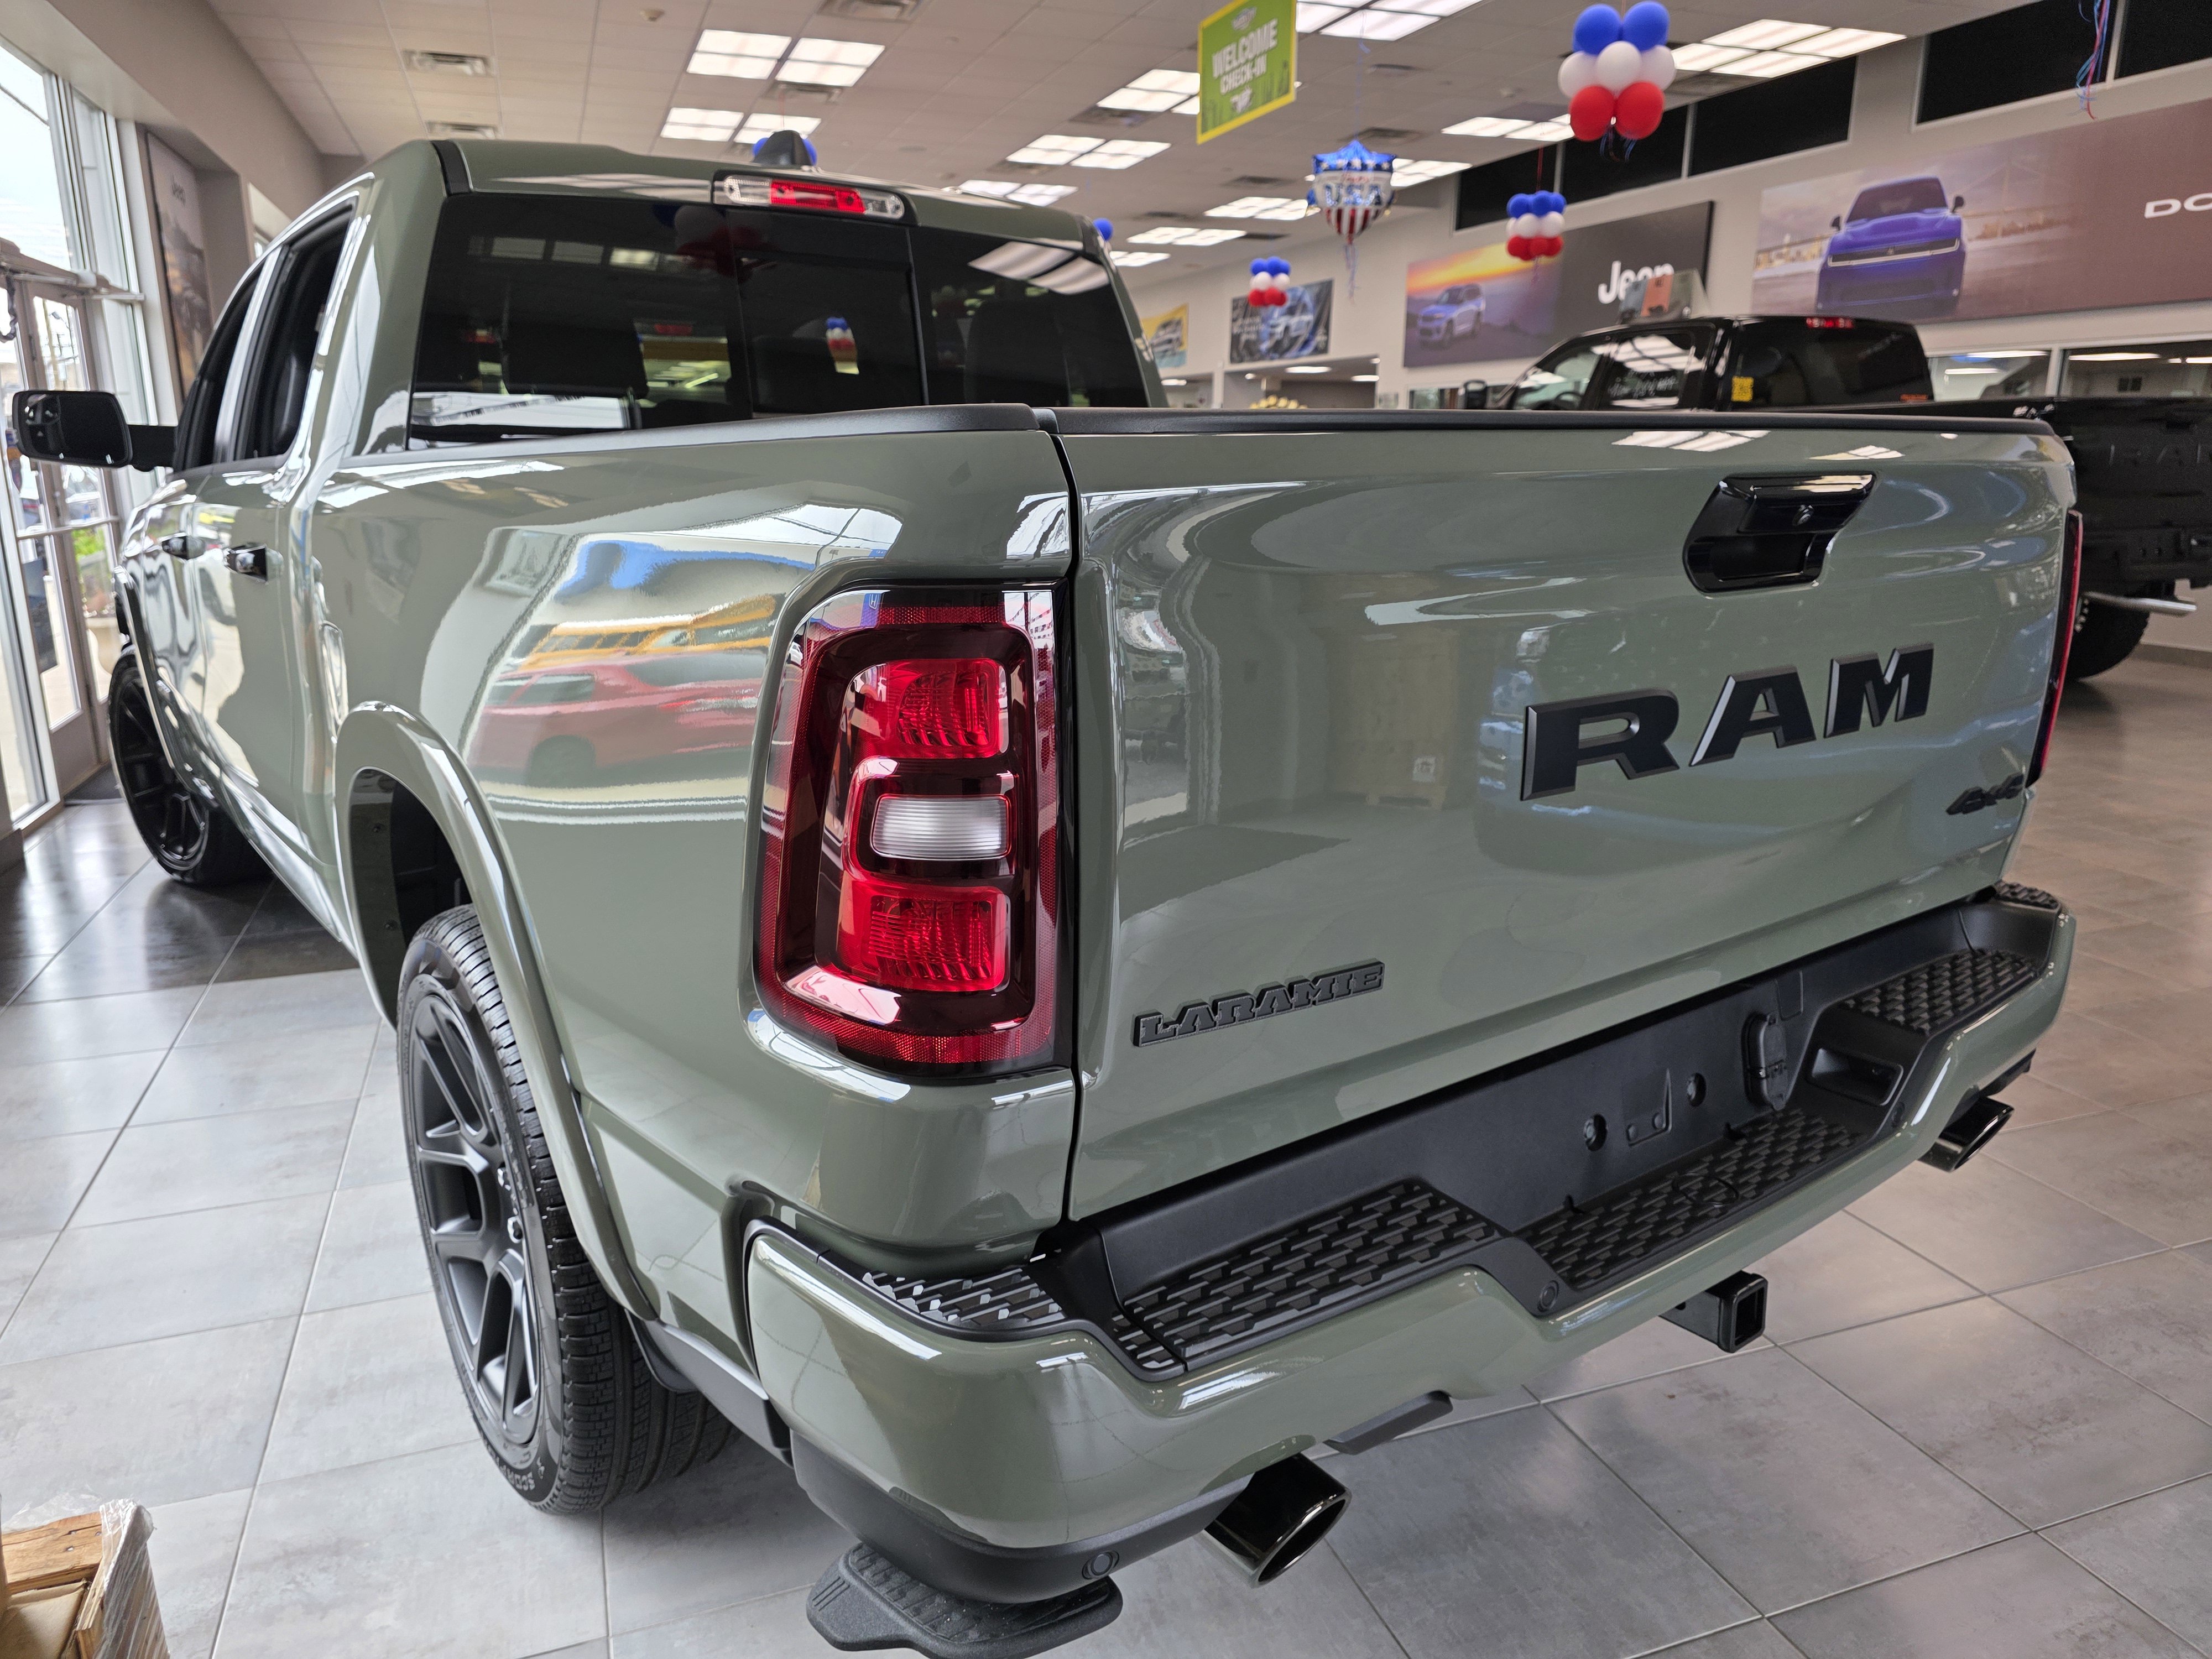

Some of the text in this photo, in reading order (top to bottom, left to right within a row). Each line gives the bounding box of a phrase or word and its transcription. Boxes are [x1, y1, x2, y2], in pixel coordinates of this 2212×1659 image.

[1212, 18, 1278, 79] WELCOME
[1220, 54, 1267, 95] CHECK-IN
[1325, 184, 1381, 206] USA
[1520, 643, 1934, 801] RAM
[1130, 958, 1385, 1047] LARAMIE
